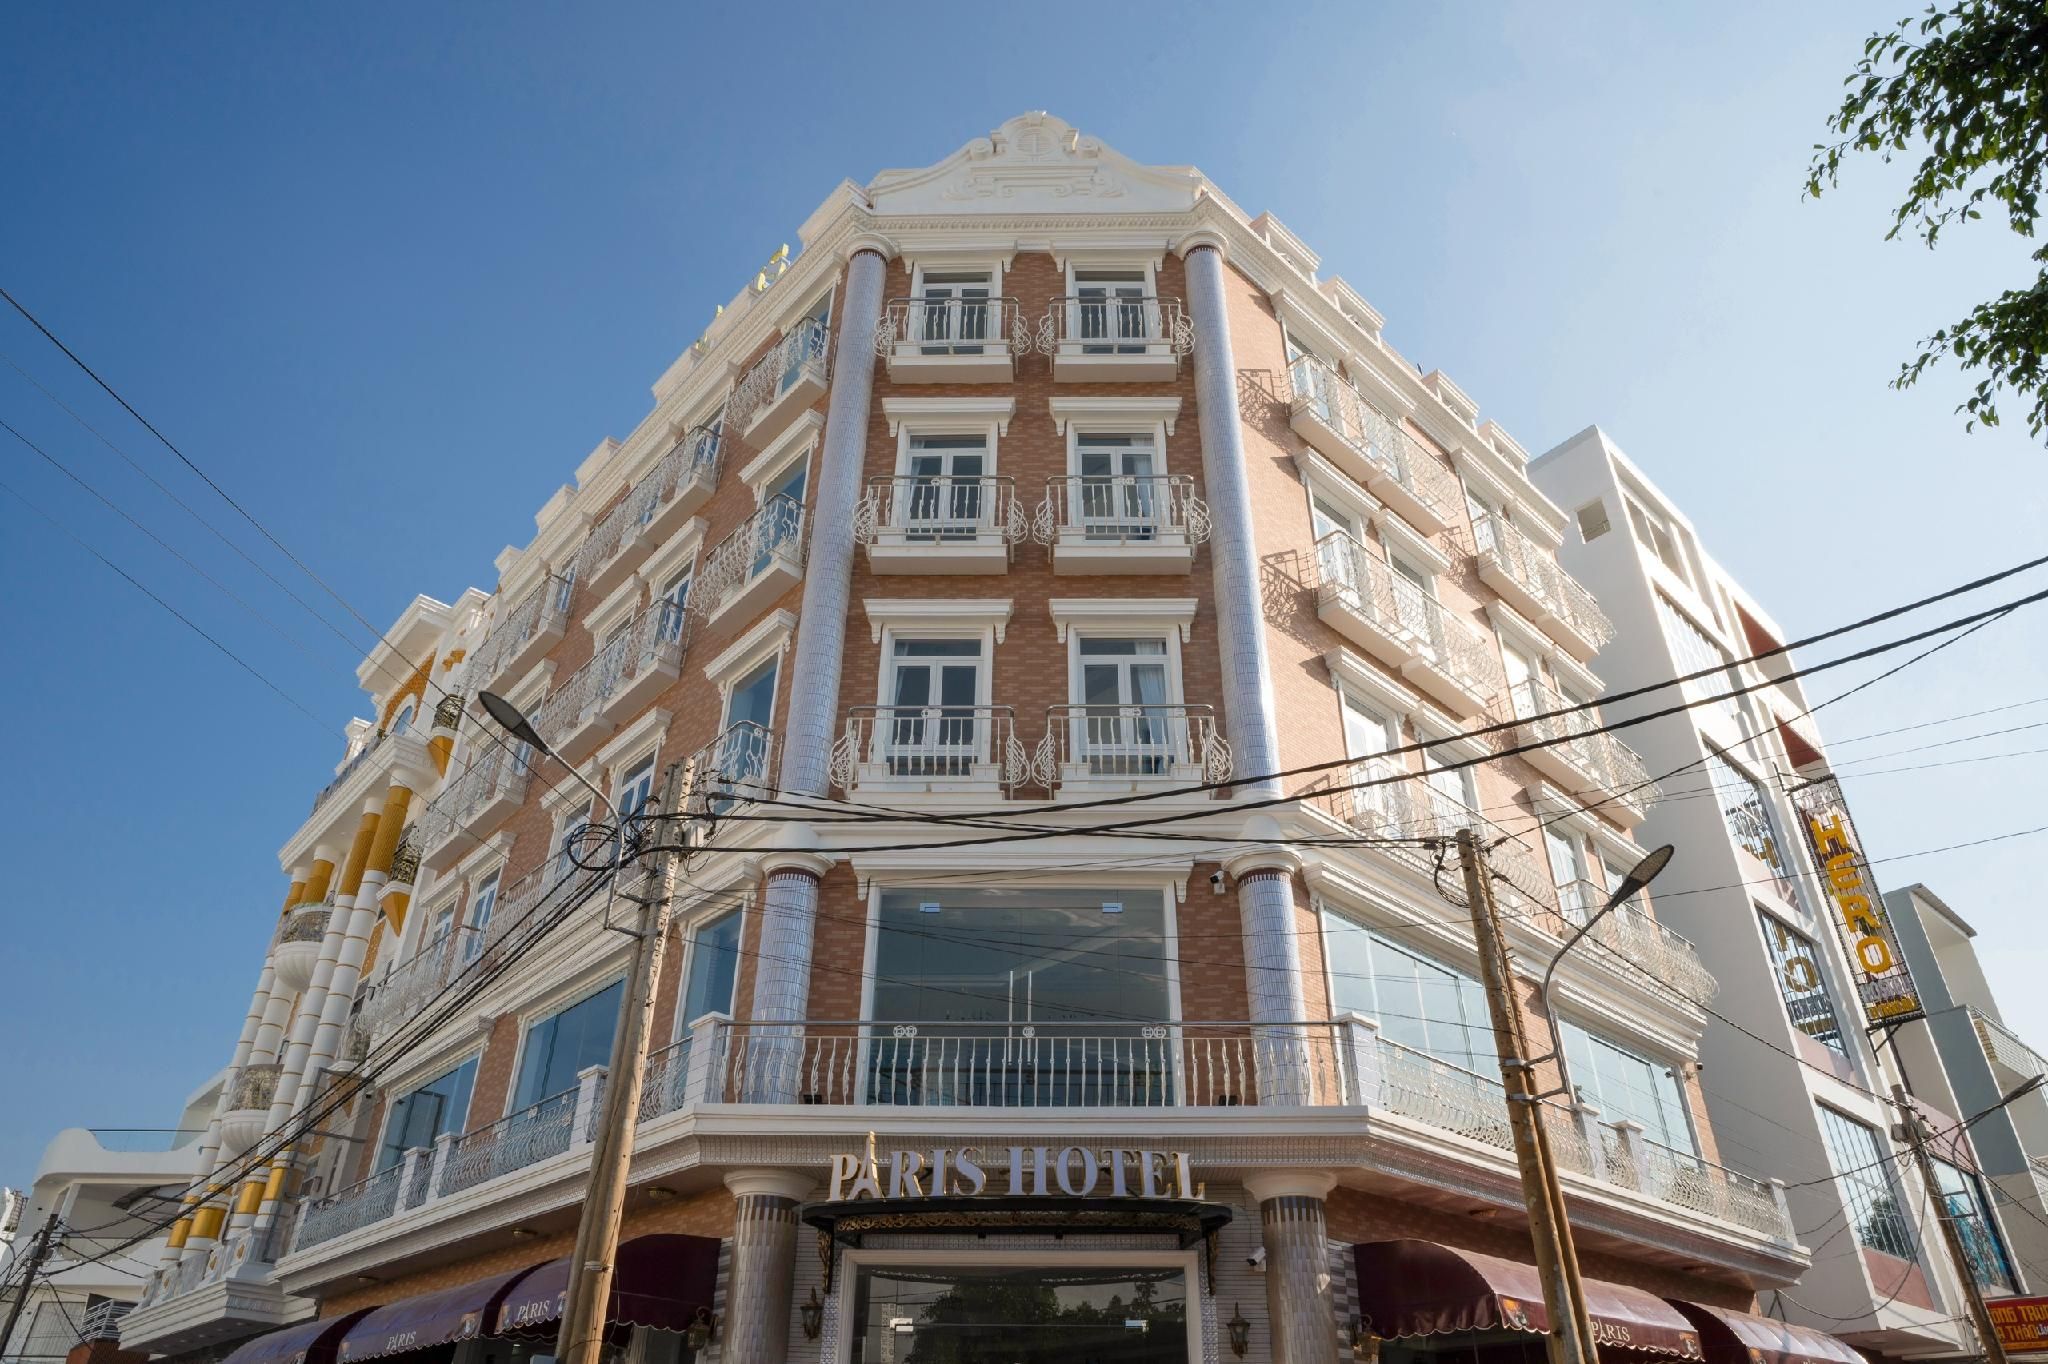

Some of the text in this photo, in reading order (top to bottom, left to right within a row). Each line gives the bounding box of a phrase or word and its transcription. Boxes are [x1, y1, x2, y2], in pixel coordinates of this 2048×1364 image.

[1809, 814, 1894, 974] HERO
[828, 1130, 1206, 1202] PARIS HOTEL
[517, 1299, 550, 1320] PARIS
[386, 1330, 417, 1351] PARIS
[1590, 1318, 1631, 1342] PARIS
